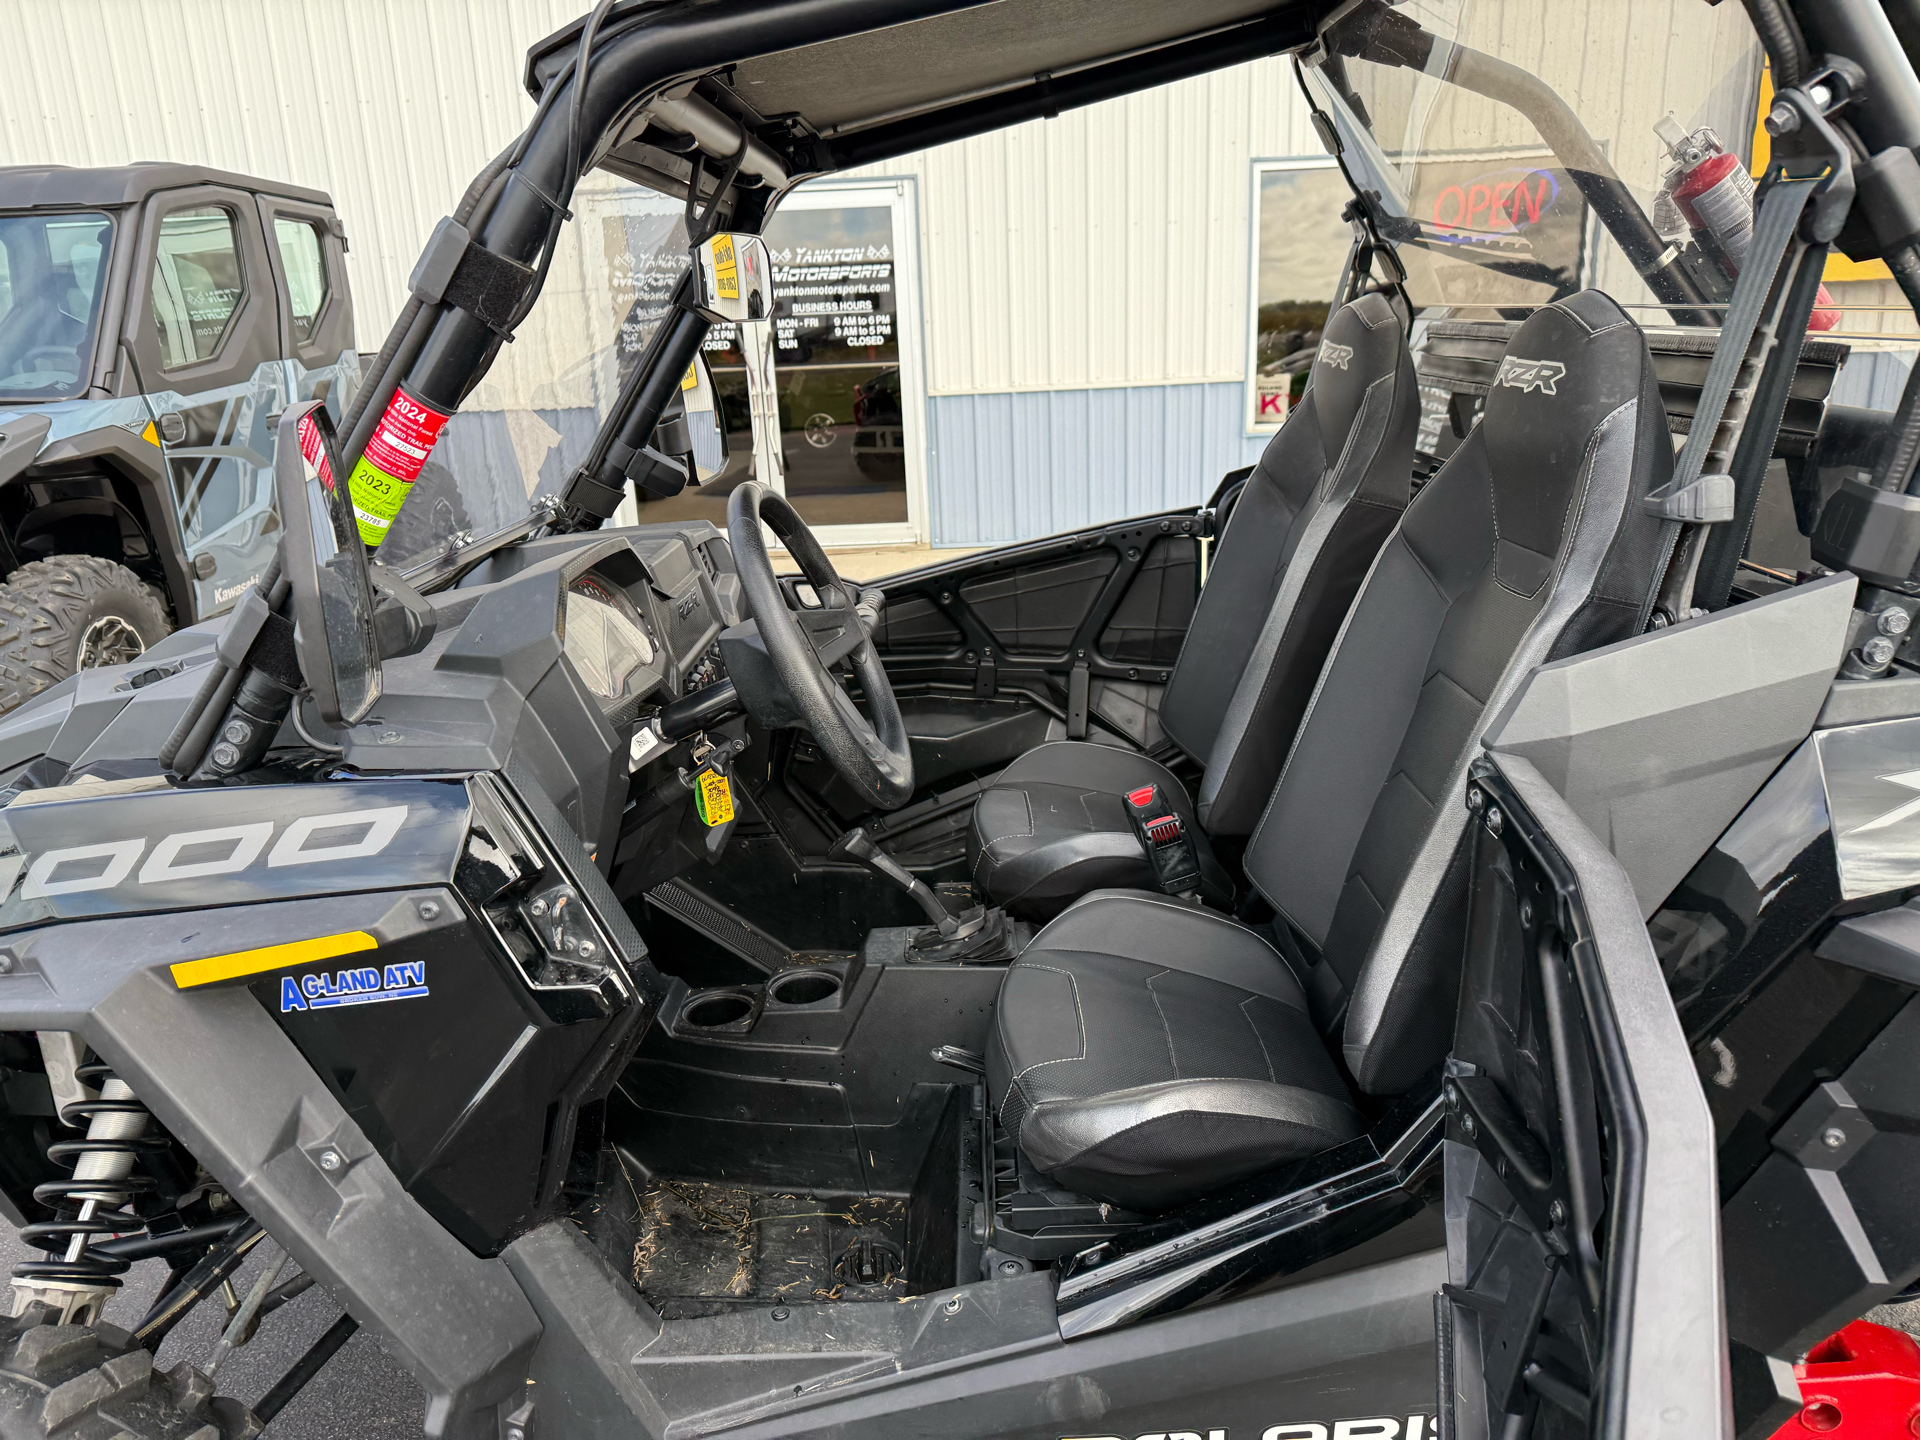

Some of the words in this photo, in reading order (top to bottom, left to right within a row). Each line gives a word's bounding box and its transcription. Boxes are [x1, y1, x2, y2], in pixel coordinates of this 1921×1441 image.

[1433, 178, 1547, 232] OPEN
[796, 247, 865, 263] YANKTON
[772, 264, 891, 282] MOTORSPORTS
[773, 283, 891, 297] yanktonmotorsports.com
[792, 302, 839, 312] BUSINESS
[840, 300, 873, 311] HOURS
[776, 318, 798, 328] MON
[804, 318, 819, 327] FRI
[834, 317, 840, 326] 9
[842, 316, 857, 326] AM
[858, 316, 867, 325] to
[868, 315, 875, 325] 6
[876, 315, 890, 325] PM
[713, 331, 720, 340] 5
[721, 330, 736, 339] PM
[778, 329, 795, 339] SAT
[834, 327, 841, 337] 9
[843, 326, 857, 336] AM
[859, 326, 867, 335] to
[869, 326, 876, 335] 5
[877, 325, 891, 335] PM
[702, 341, 731, 350] OSED
[778, 339, 798, 349] SUN
[847, 336, 885, 346] CLOSED
[1493, 355, 1566, 396] RZR
[394, 397, 428, 424] 2024
[395, 441, 416, 456] 27523
[407, 435, 423, 449] TRAIL
[358, 469, 392, 495] 2023
[360, 512, 382, 526] 23785
[371, 506, 387, 518] TRAIL
[214, 573, 259, 605] Kawasaki
[384, 960, 425, 989] ATV
